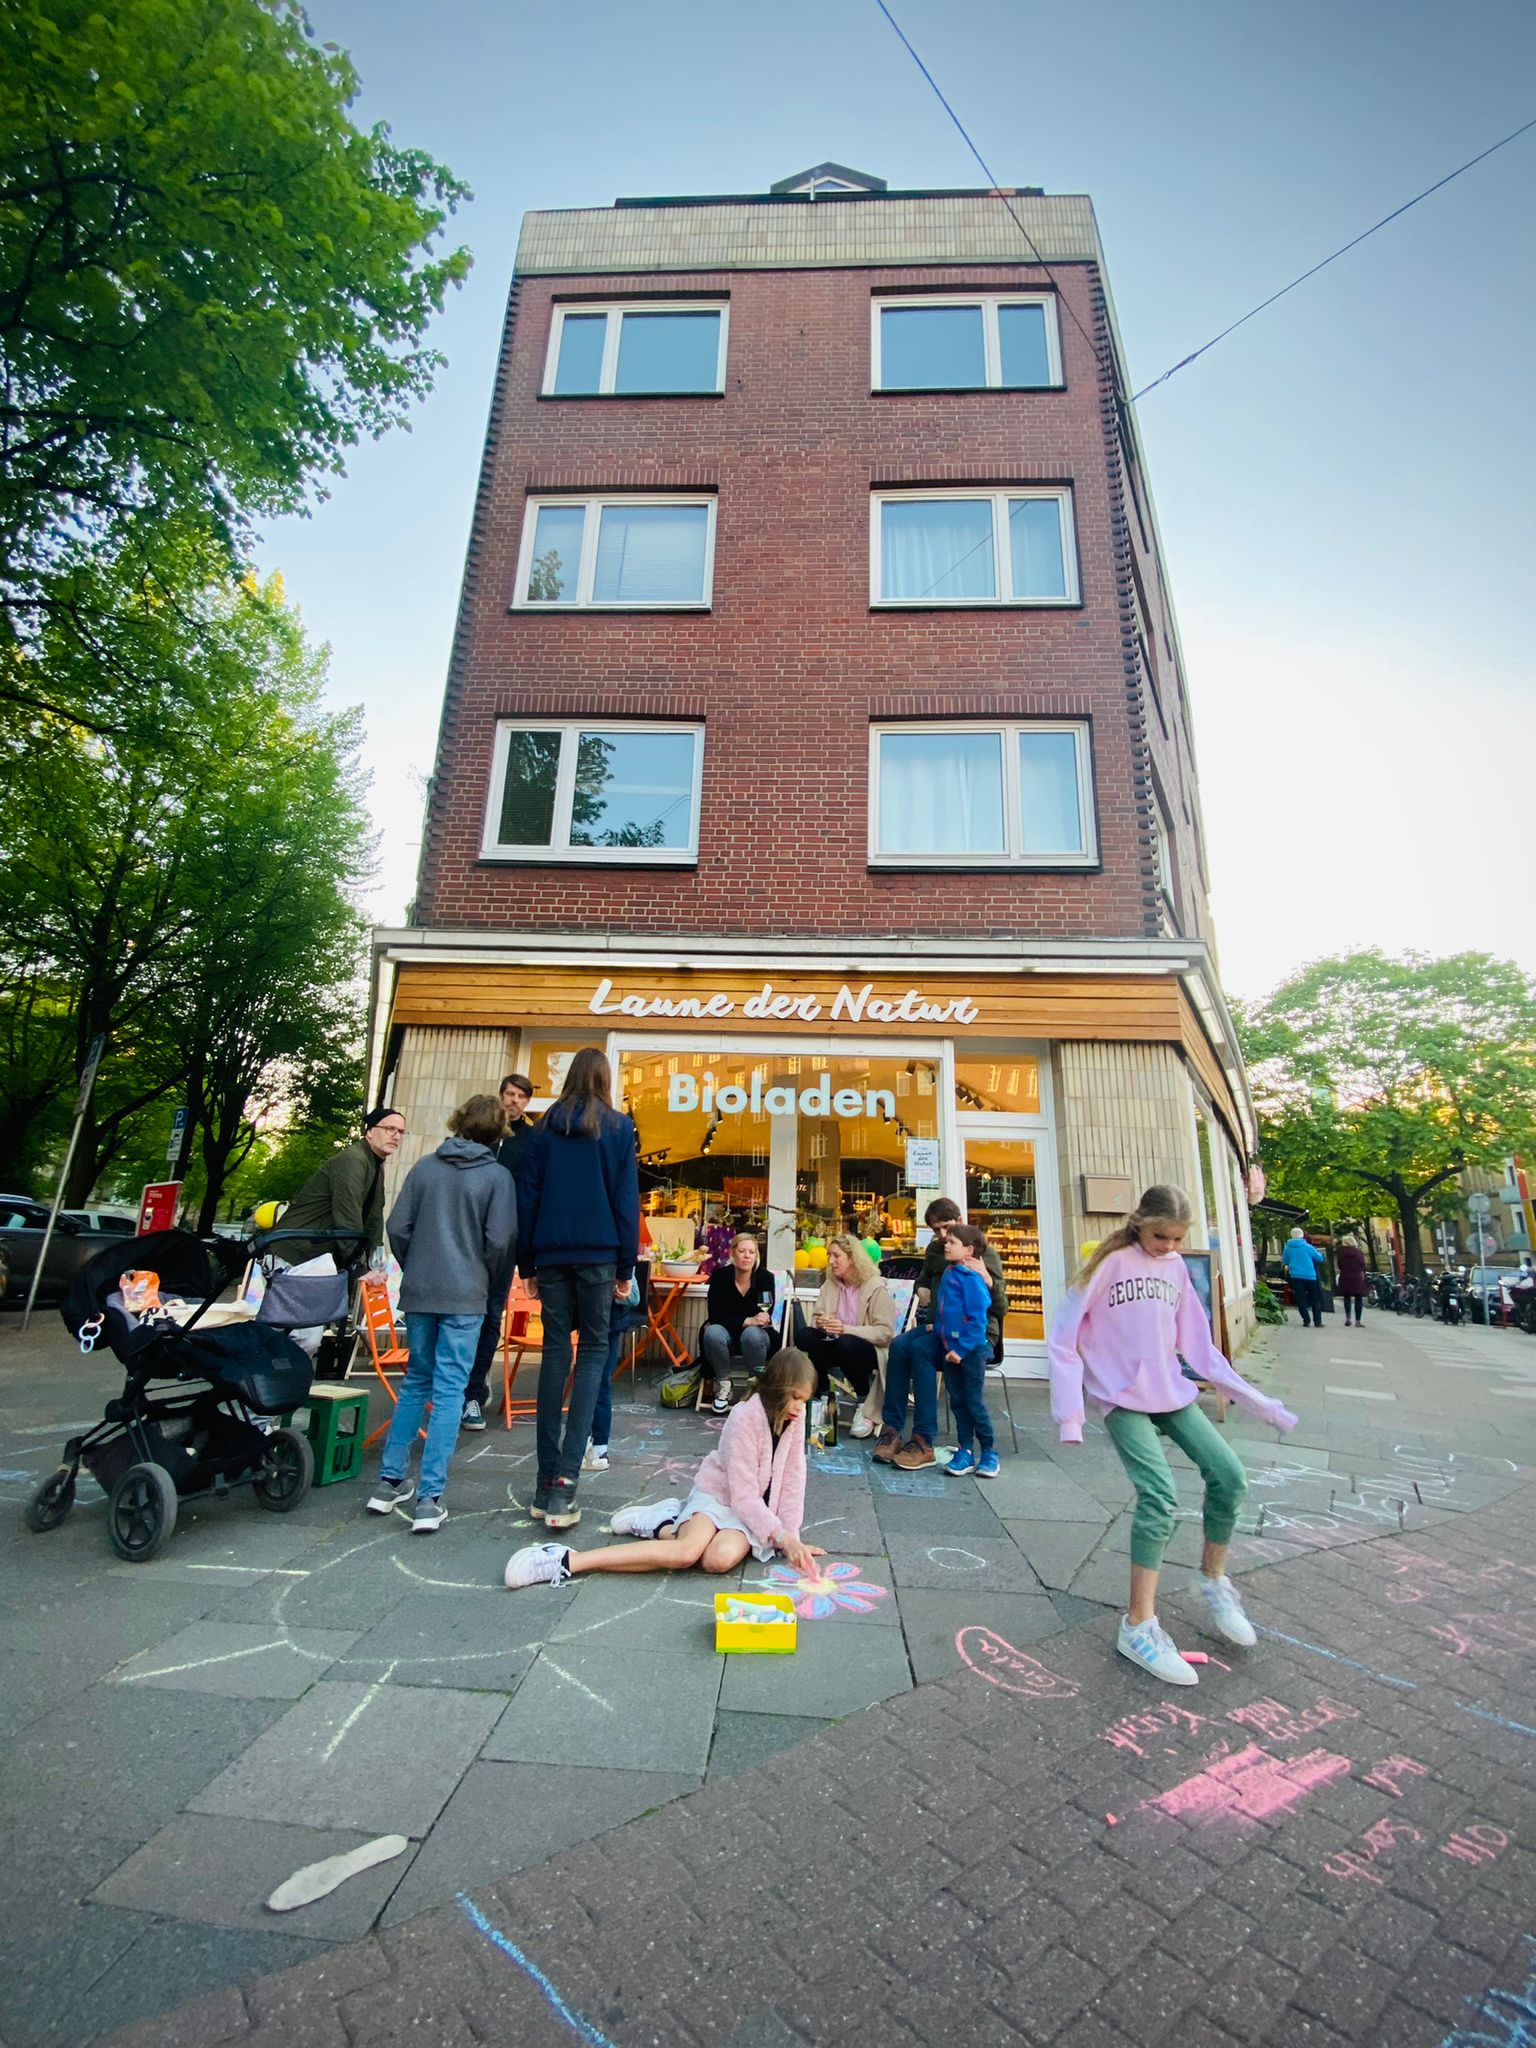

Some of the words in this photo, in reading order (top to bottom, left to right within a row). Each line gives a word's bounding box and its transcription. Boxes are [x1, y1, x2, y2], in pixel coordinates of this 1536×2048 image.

[588, 979, 734, 1018] Laune
[743, 983, 822, 1022] der
[830, 983, 979, 1024] Natur
[668, 1071, 896, 1118] Bioladen
